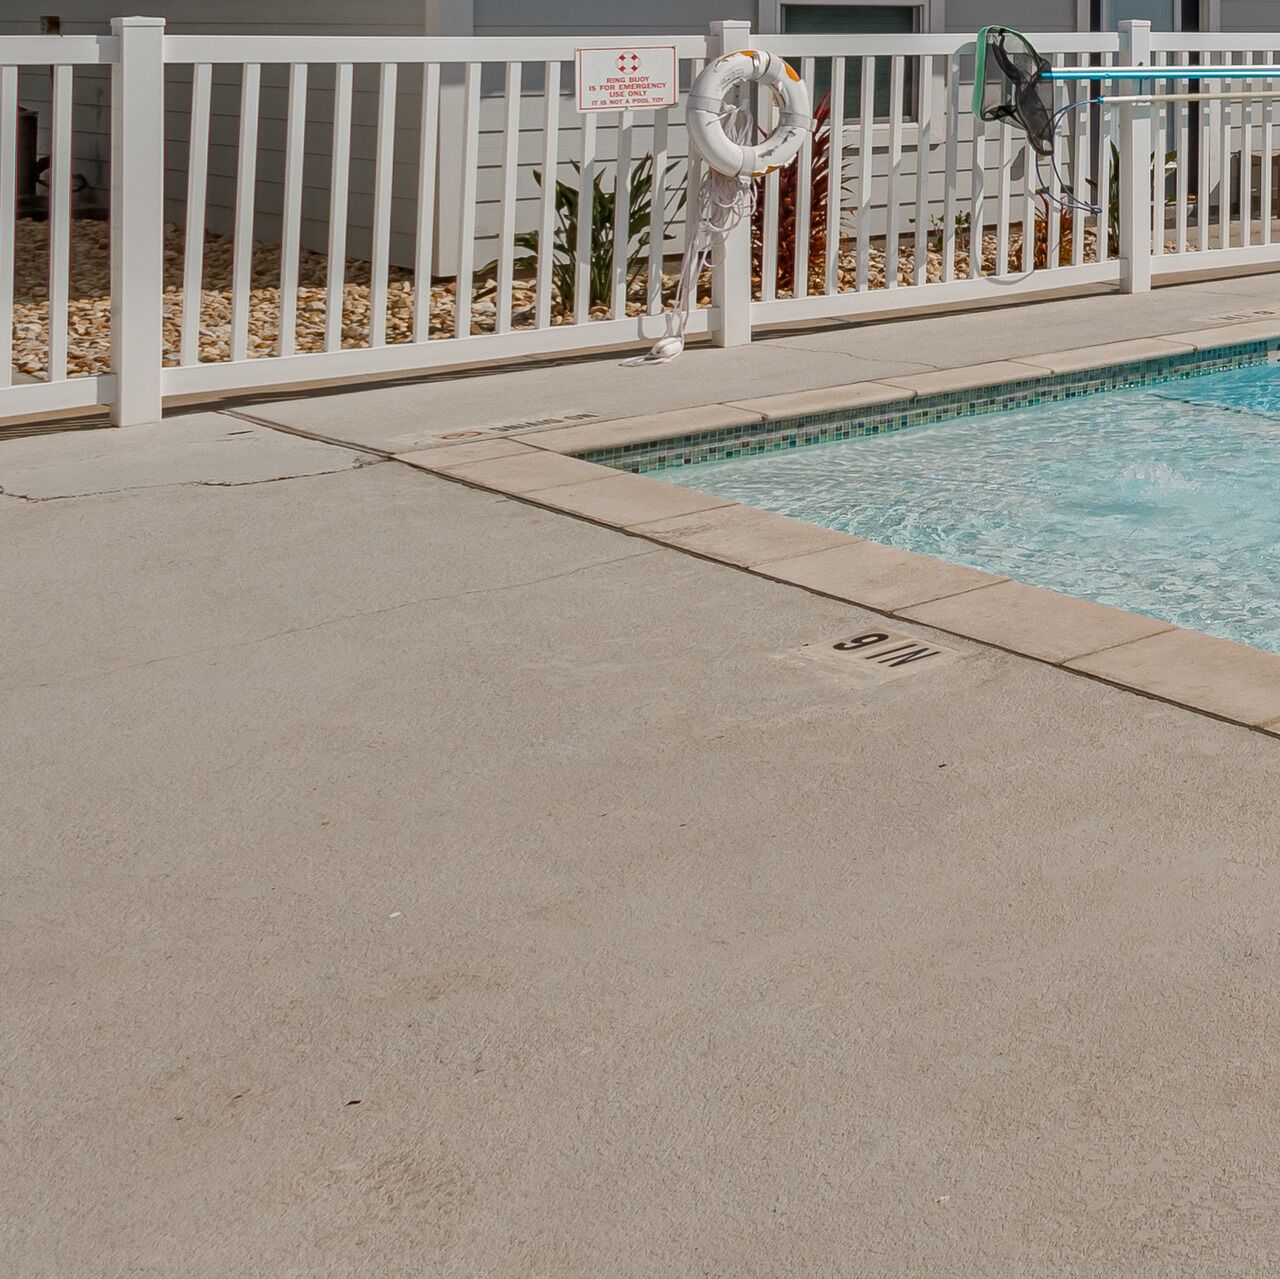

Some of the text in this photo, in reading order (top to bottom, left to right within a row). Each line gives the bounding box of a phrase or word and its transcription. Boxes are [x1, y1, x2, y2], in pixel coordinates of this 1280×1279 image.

[618, 82, 667, 90] EMERGENCY
[832, 632, 941, 668] 9 IN
